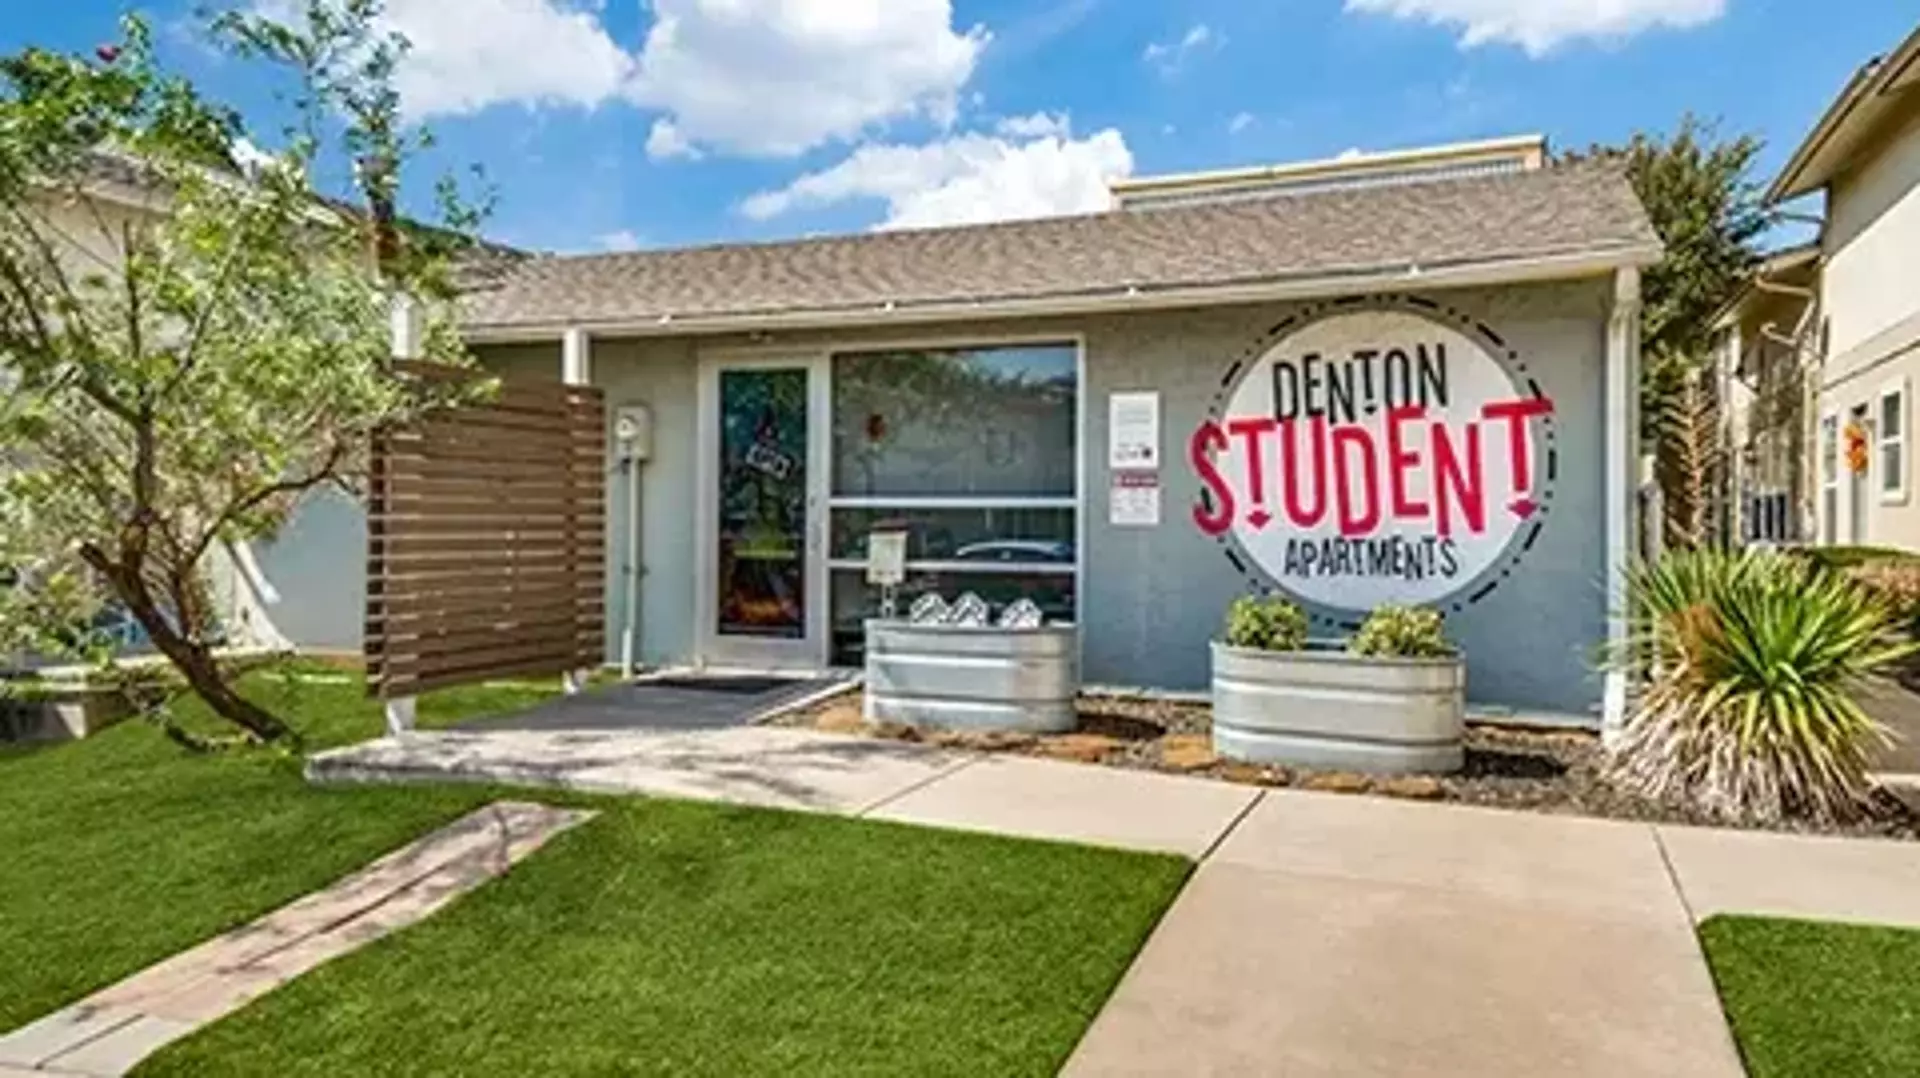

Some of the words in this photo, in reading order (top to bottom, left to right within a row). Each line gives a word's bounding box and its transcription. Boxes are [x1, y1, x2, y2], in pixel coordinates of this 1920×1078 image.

[1272, 343, 1449, 424] DENTON
[1190, 397, 1554, 536] STUDENT
[1284, 538, 1459, 581] APARTMENTS
